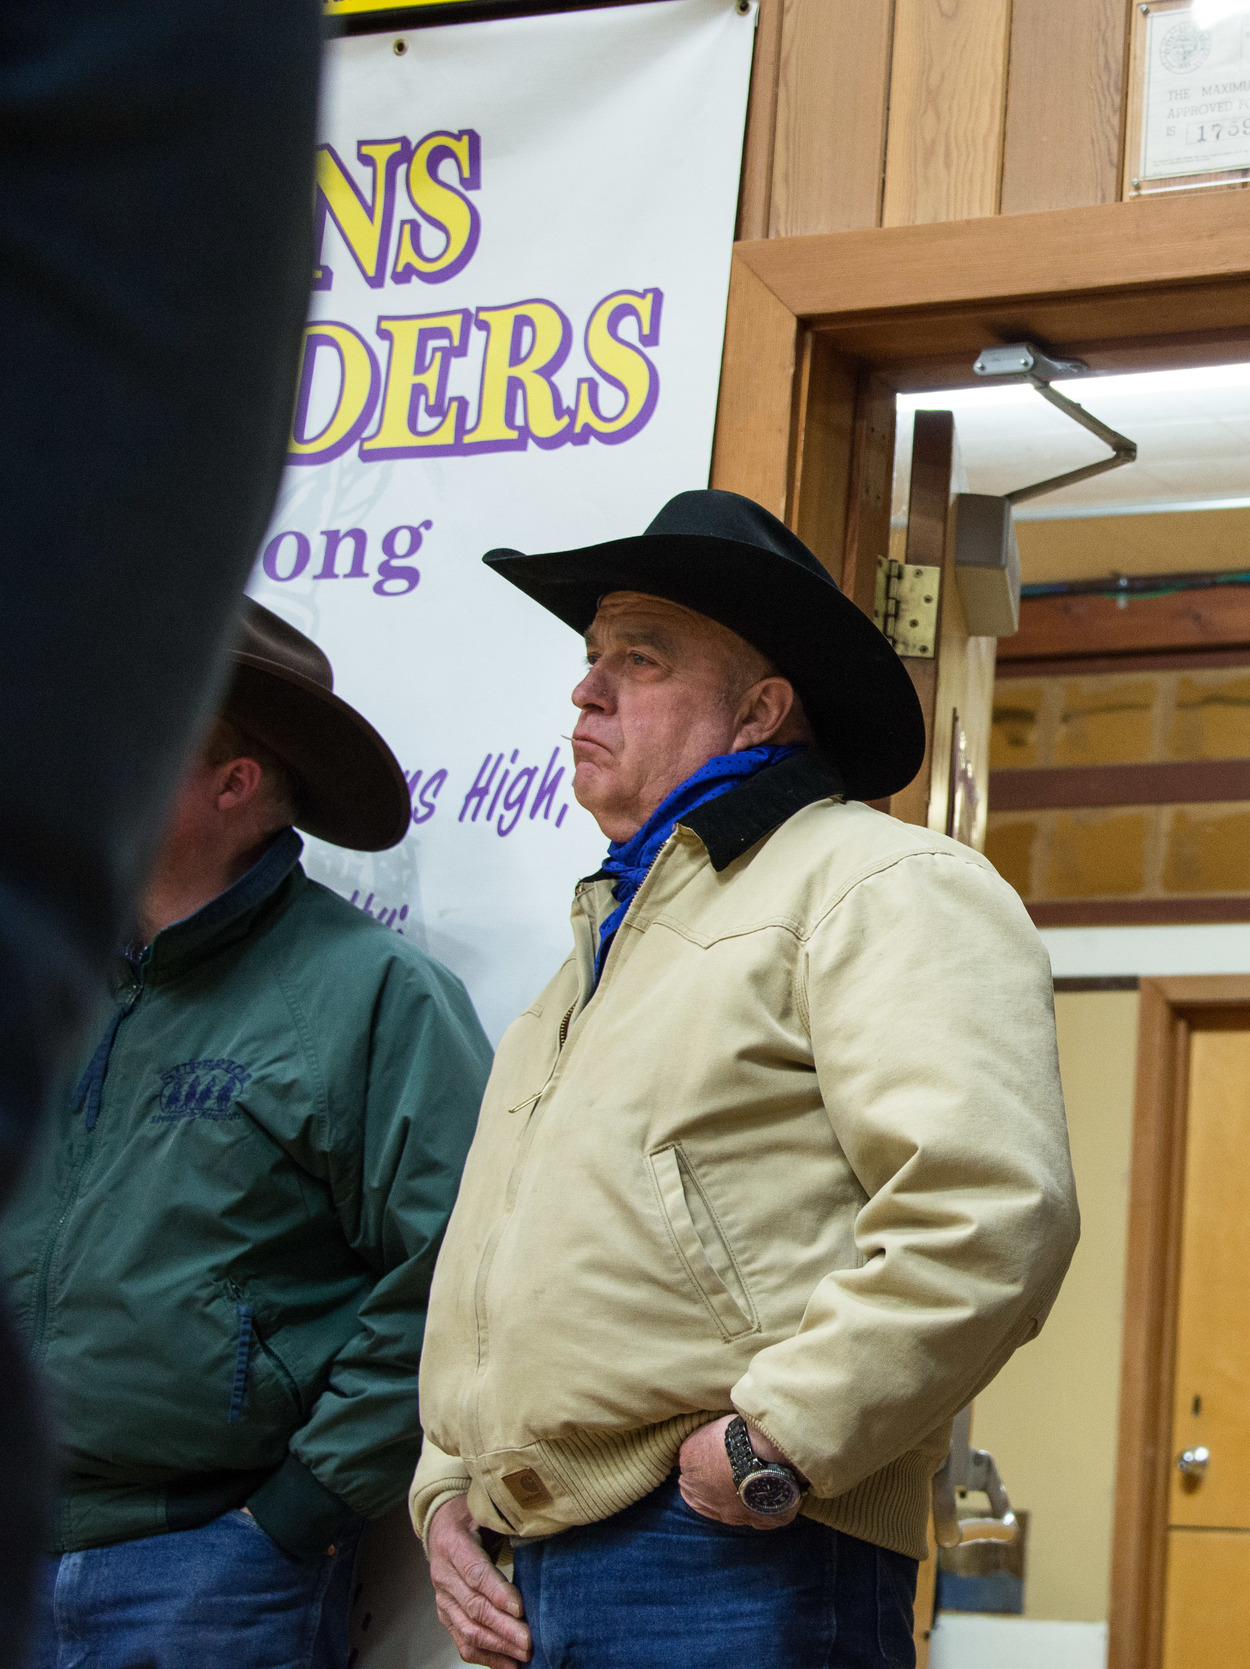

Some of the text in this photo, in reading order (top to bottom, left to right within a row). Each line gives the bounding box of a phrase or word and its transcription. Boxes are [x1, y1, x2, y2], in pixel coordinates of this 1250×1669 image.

[1167, 88, 1190, 102] THE
[1167, 100, 1233, 119] APPROVED
[1166, 126, 1176, 137] IS
[262, 519, 434, 597] ong
[457, 746, 569, 838] High,
